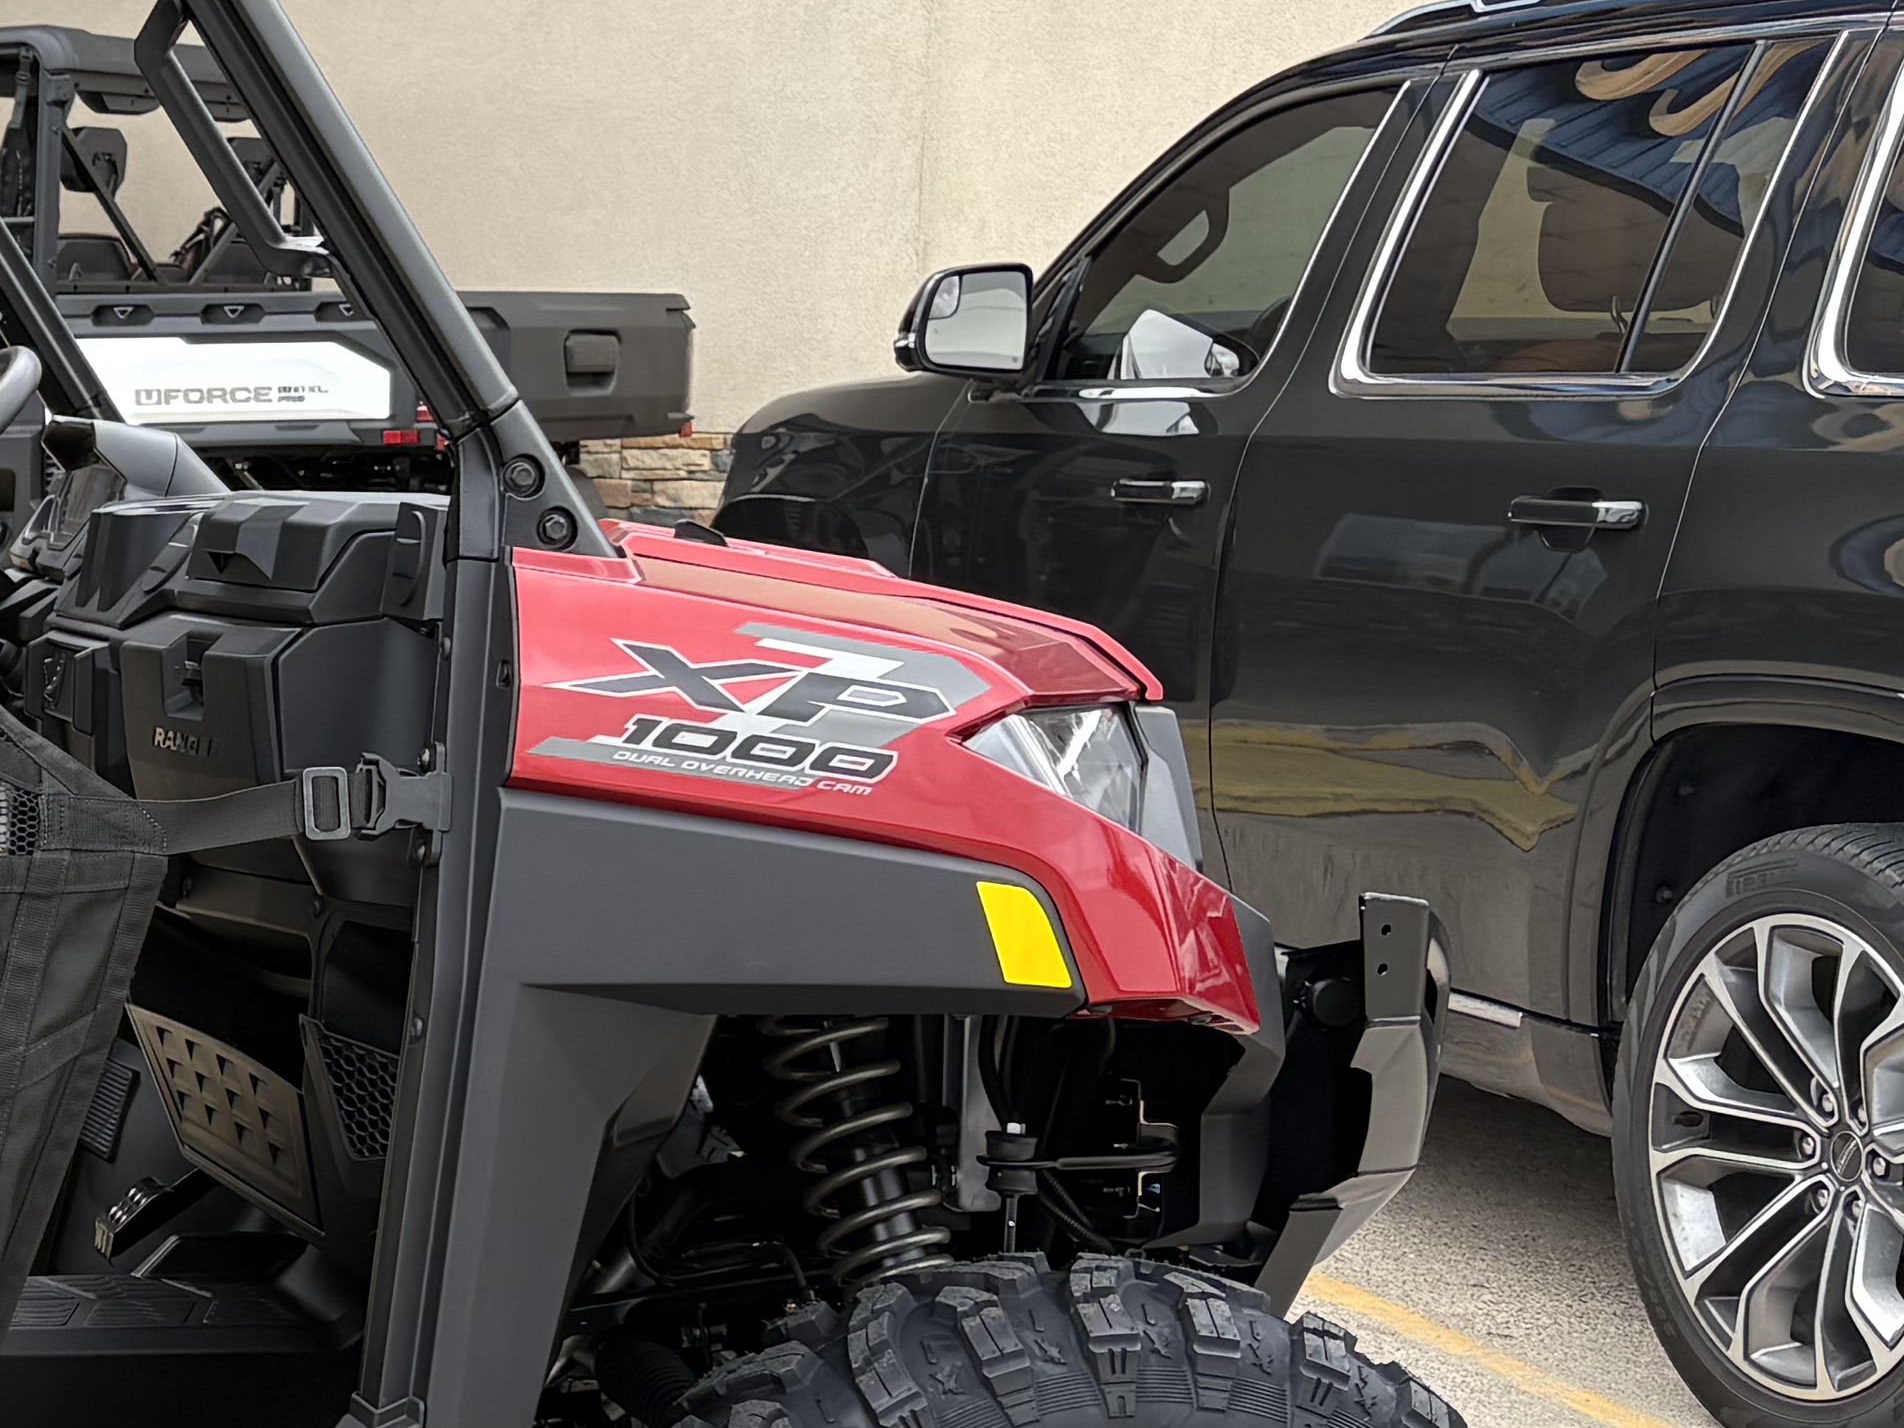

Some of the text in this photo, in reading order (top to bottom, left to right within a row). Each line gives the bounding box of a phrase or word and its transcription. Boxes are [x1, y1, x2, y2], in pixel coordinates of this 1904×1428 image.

[540, 637, 957, 725] XP
[153, 726, 214, 757] RANG
[618, 713, 898, 783] 1000
[613, 750, 873, 796] DUAL OVERHEAD CAM
